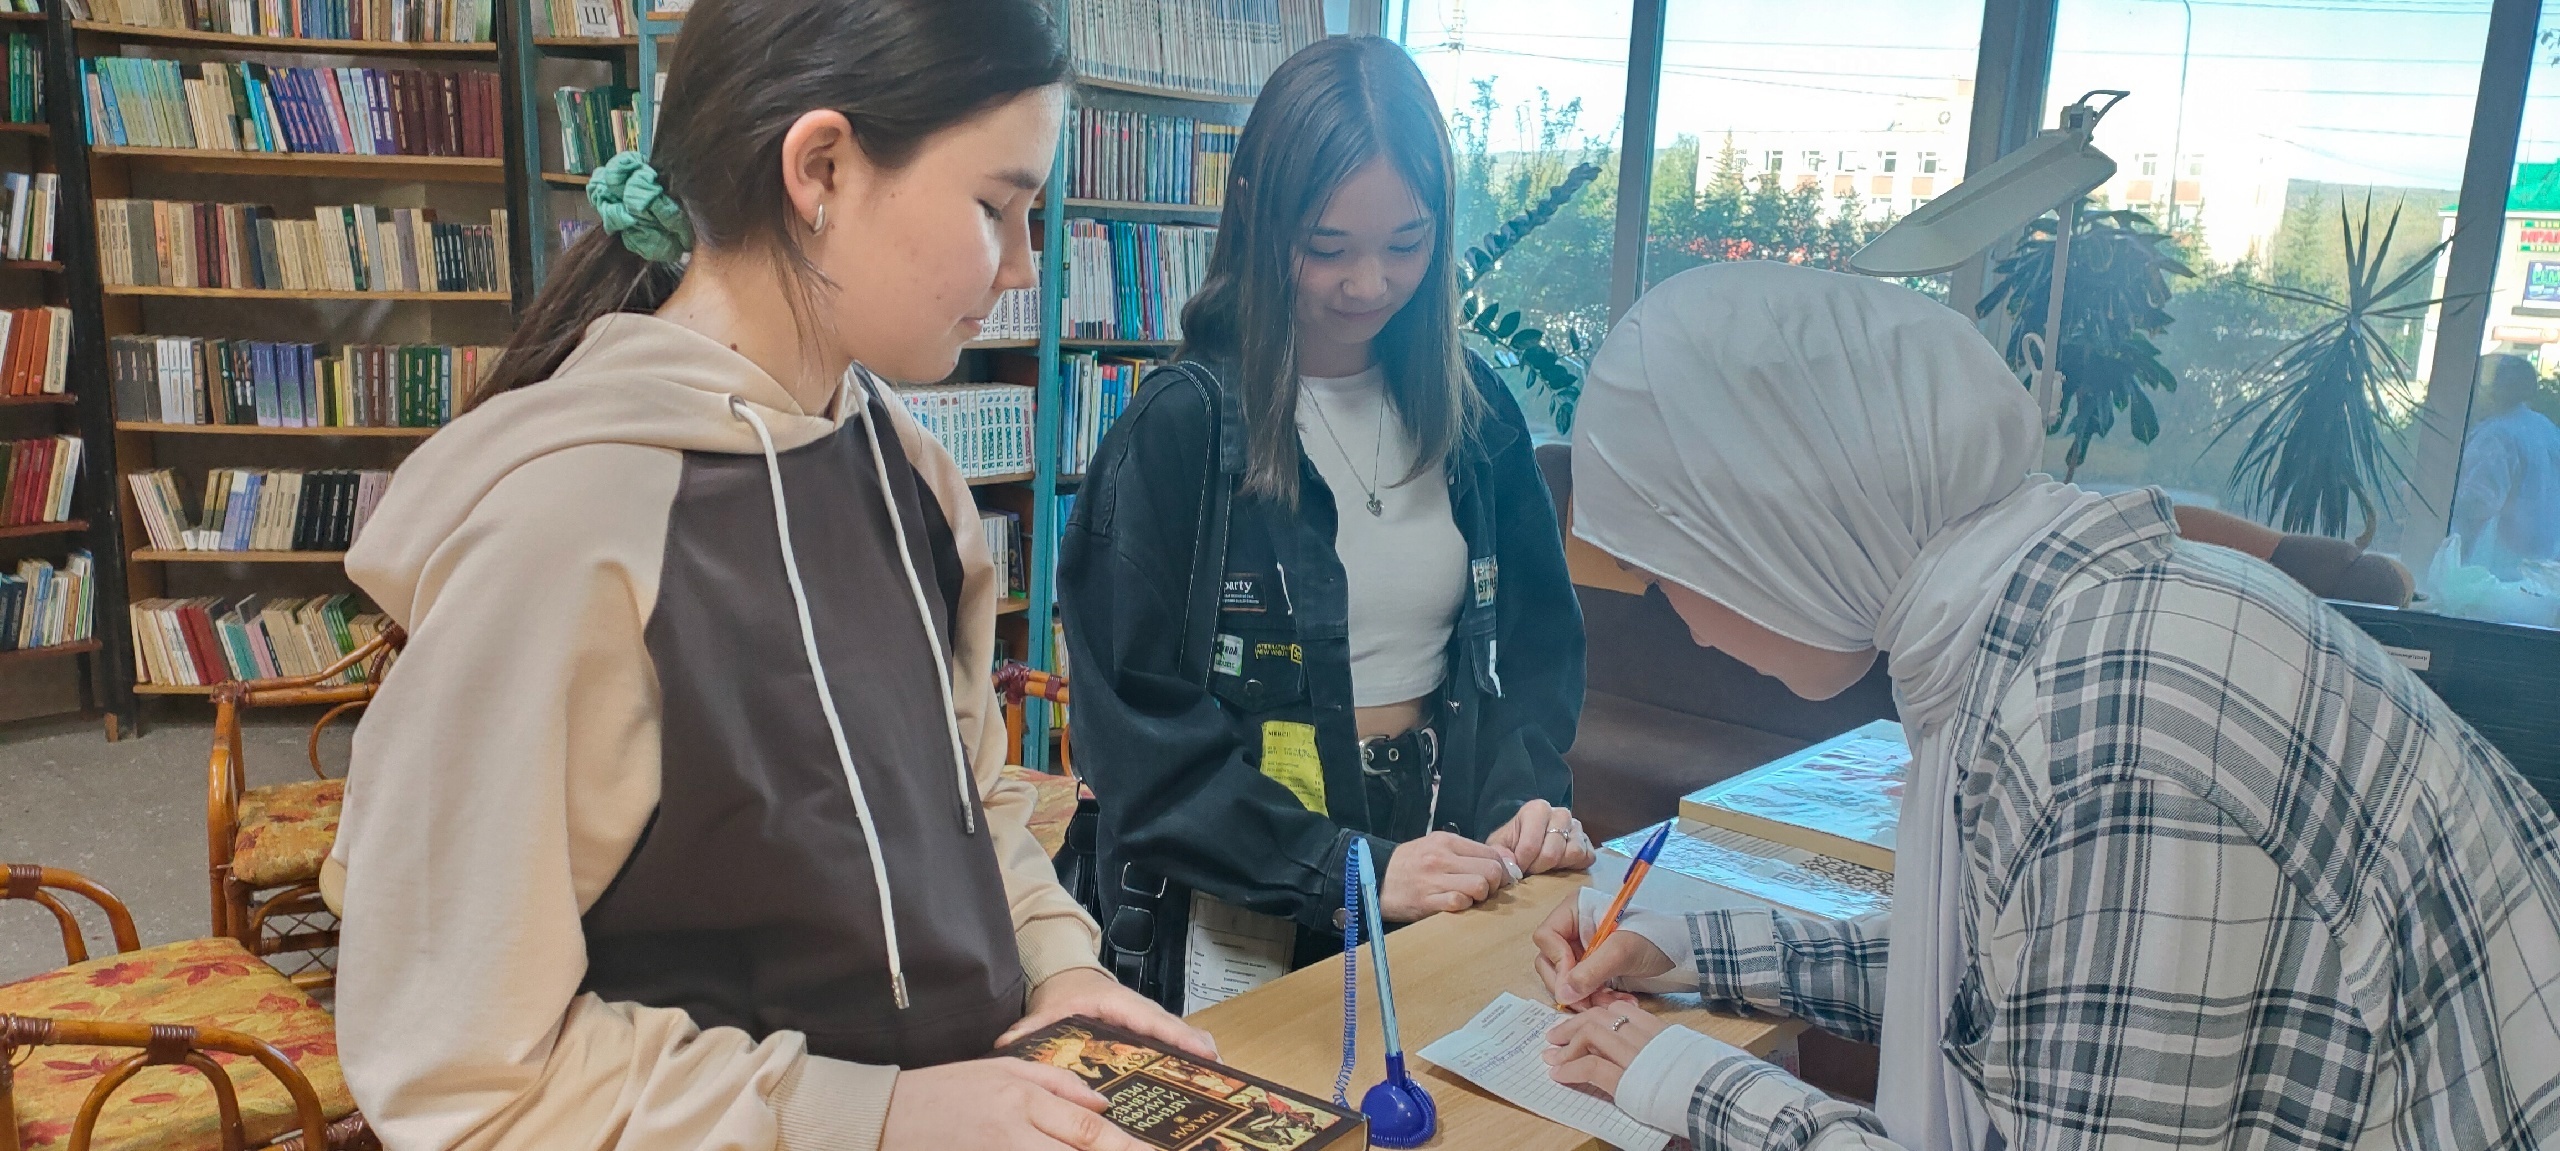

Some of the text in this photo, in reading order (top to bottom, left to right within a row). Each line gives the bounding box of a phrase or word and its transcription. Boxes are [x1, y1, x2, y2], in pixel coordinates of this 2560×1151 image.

[1106, 1085, 1165, 1120] ДРЕВНЕЙ
[1107, 1082, 1149, 1108] ГРЕЦИ
[1118, 1090, 1181, 1127] И МИФЫ
[1133, 1096, 1191, 1132] ЛЕГЕНДЫ
